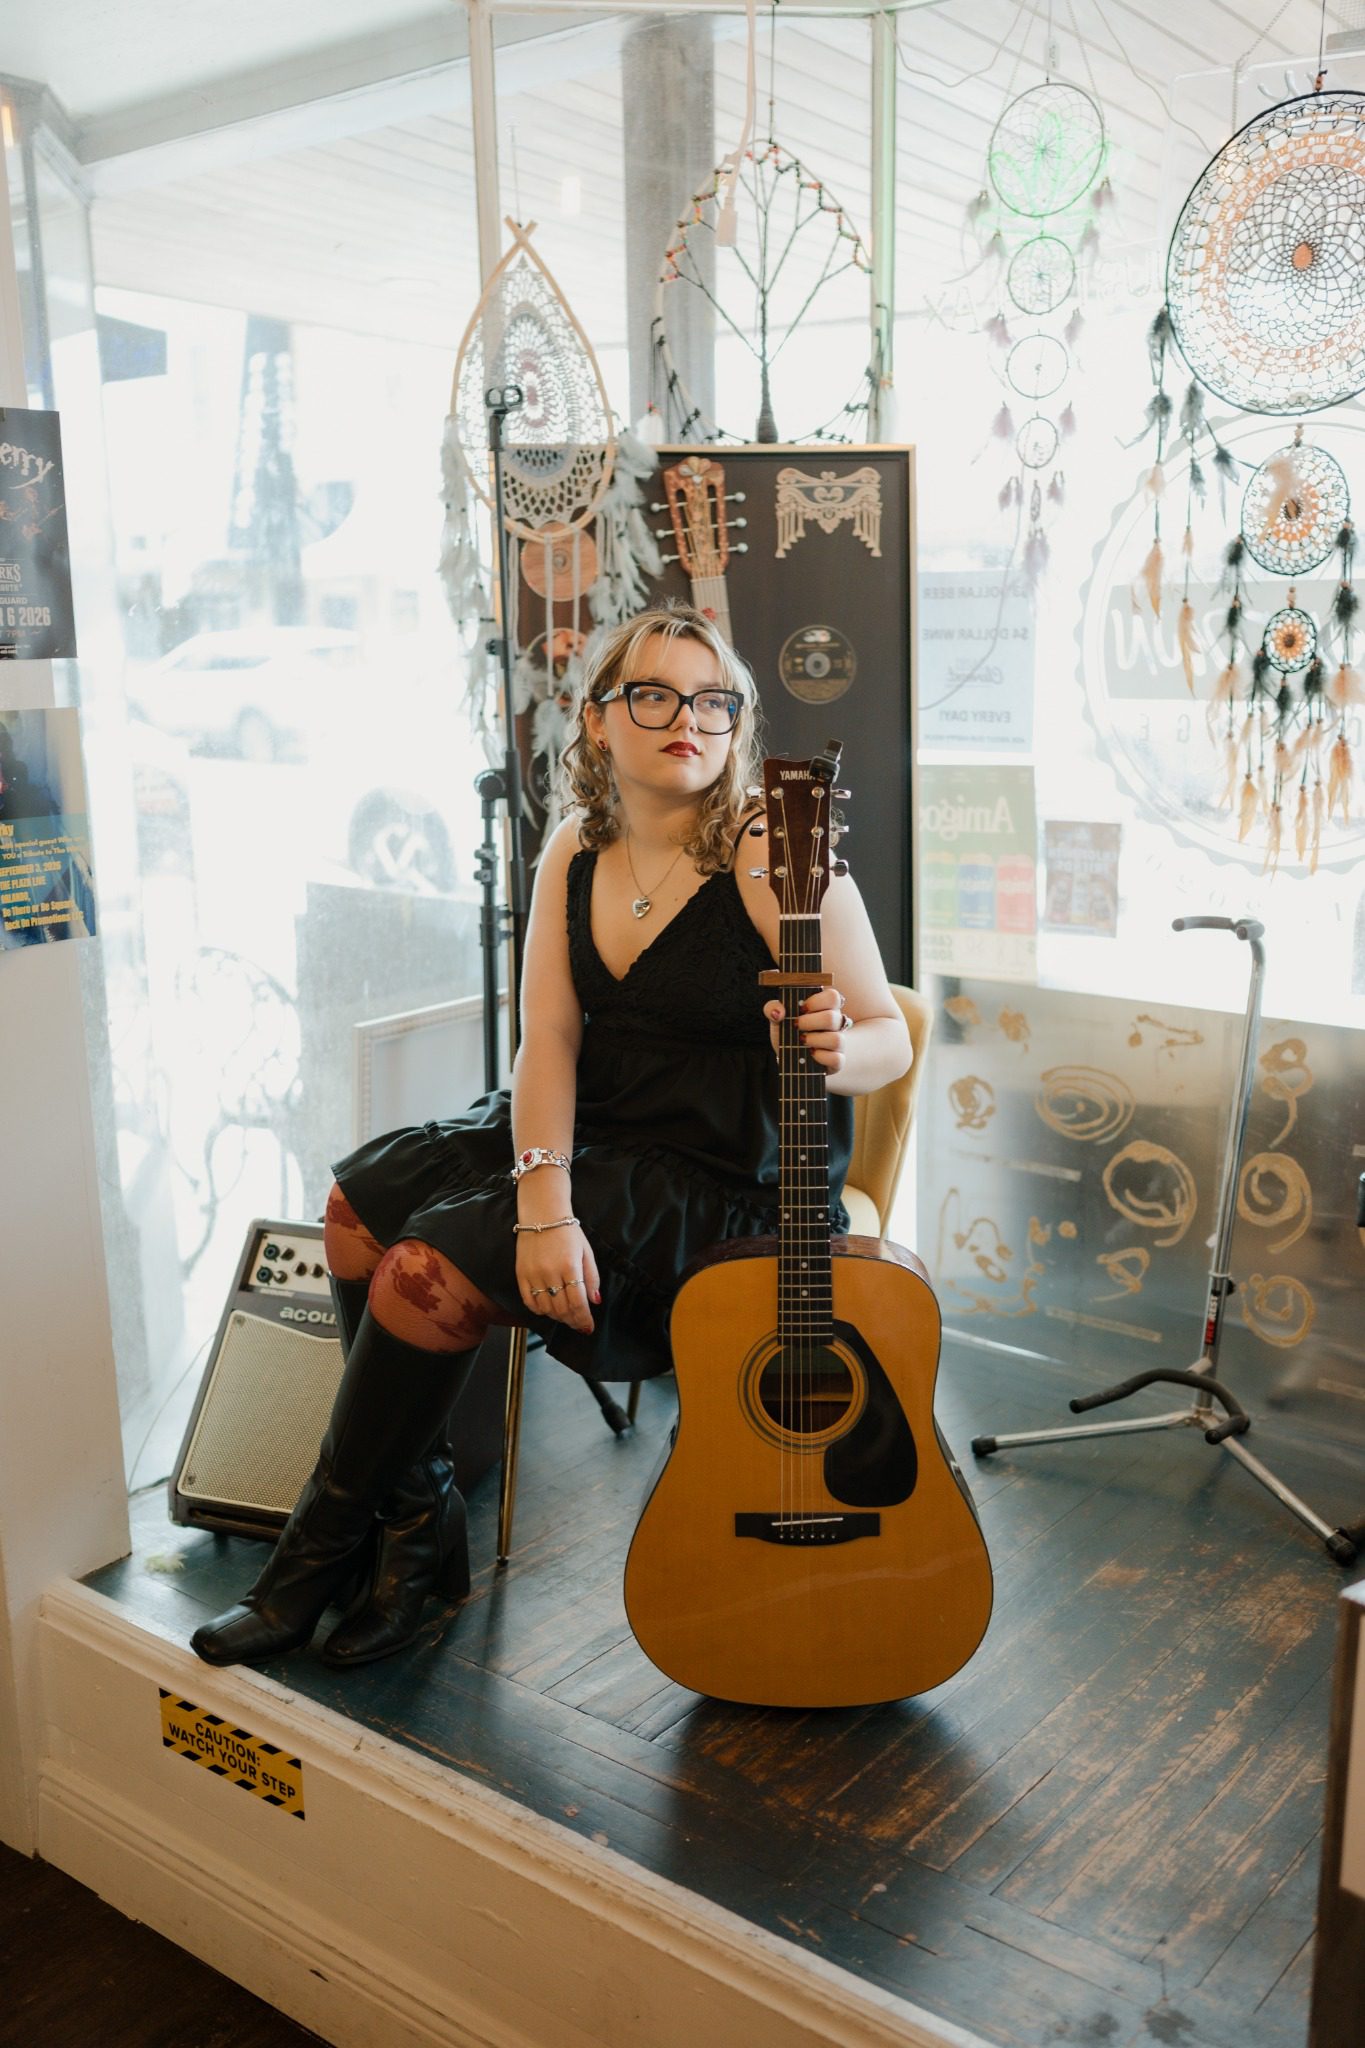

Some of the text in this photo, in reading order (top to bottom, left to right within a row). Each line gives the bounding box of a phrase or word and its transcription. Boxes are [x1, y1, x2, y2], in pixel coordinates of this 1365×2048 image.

[7, 607, 15, 626] 6
[19, 606, 51, 626] 2026
[280, 1306, 338, 1327] acou
[168, 1722, 296, 1798] WATCH YOUR STEP
[195, 1722, 261, 1766] CAUTION:
